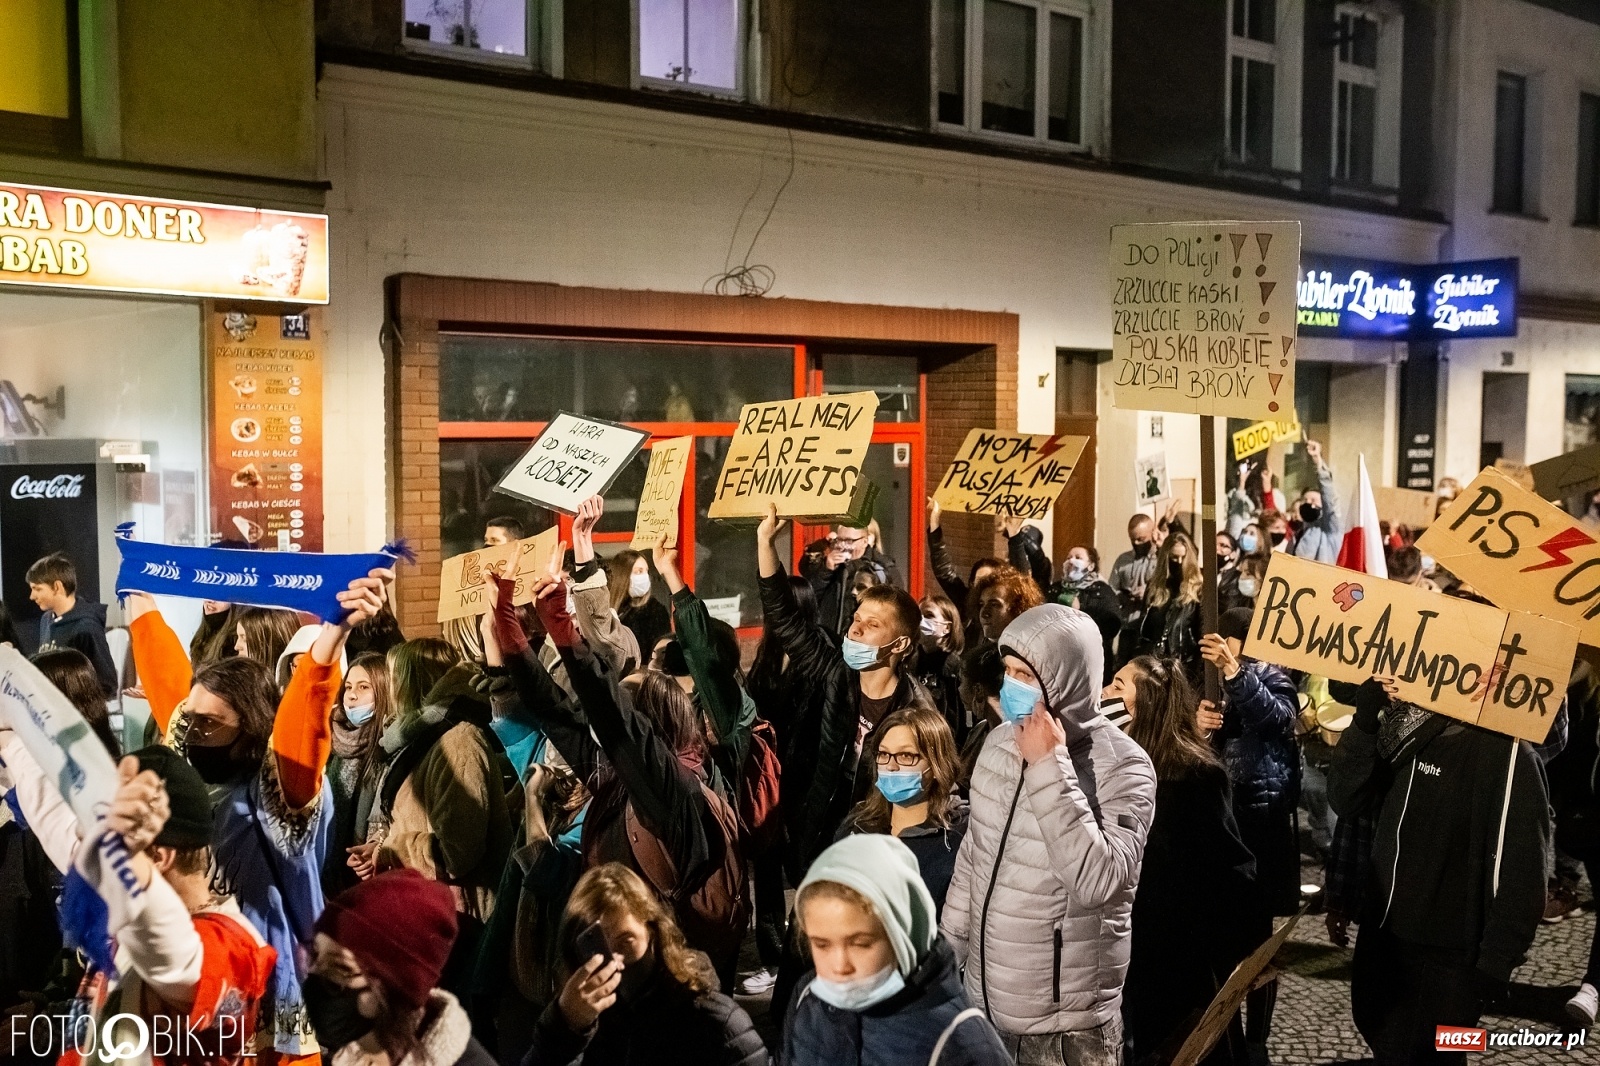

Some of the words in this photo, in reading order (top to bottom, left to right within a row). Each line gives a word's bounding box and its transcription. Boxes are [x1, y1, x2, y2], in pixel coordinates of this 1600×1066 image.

[62, 196, 206, 245] DONER
[0, 234, 89, 276] BAB
[1123, 243, 1160, 266] DO
[1297, 270, 1349, 310] ubiler
[1434, 274, 1500, 306] Jubiler
[1194, 307, 1246, 333] BROŃ
[1185, 366, 1255, 399] BROŃ
[569, 421, 605, 441] WARA
[742, 402, 804, 435] REAL
[810, 402, 864, 432] MEN
[231, 449, 260, 458] KEBAB
[541, 436, 559, 451] OD
[562, 443, 611, 468] NASZYCH
[968, 433, 1037, 464] MOJA
[1235, 426, 1270, 456] ZŁOTO
[525, 455, 594, 494] KOBIET!
[944, 460, 1023, 494] PUSIA
[1028, 459, 1073, 488] NIE
[231, 501, 260, 509] KEBAB
[1449, 485, 1541, 560] PiS
[1417, 761, 1442, 777] night
